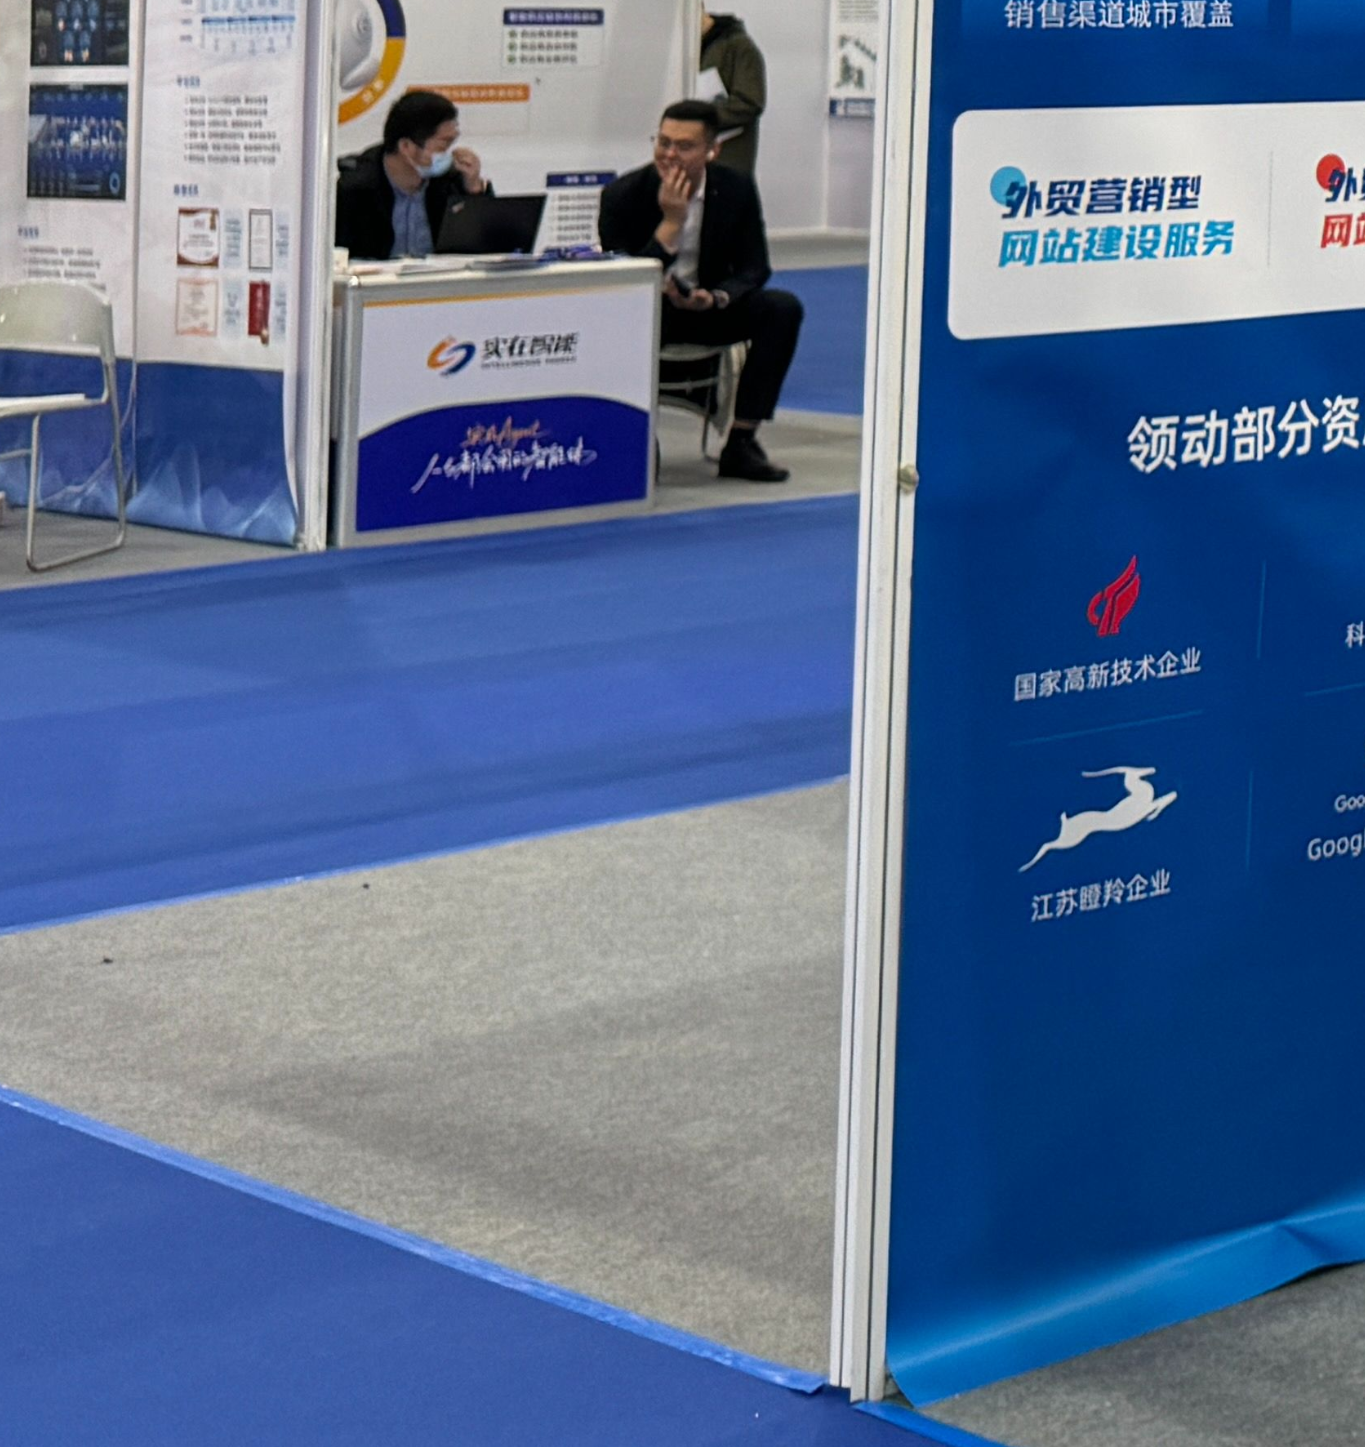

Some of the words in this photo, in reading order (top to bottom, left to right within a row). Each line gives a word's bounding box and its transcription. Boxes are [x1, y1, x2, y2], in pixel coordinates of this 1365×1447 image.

[1000, 174, 1202, 220] 外贸营销型
[998, 219, 1236, 269] 网站建设服务
[1013, 646, 1201, 702] 国家高新技术企业
[1030, 867, 1172, 923] 江苏瞪羚企业
